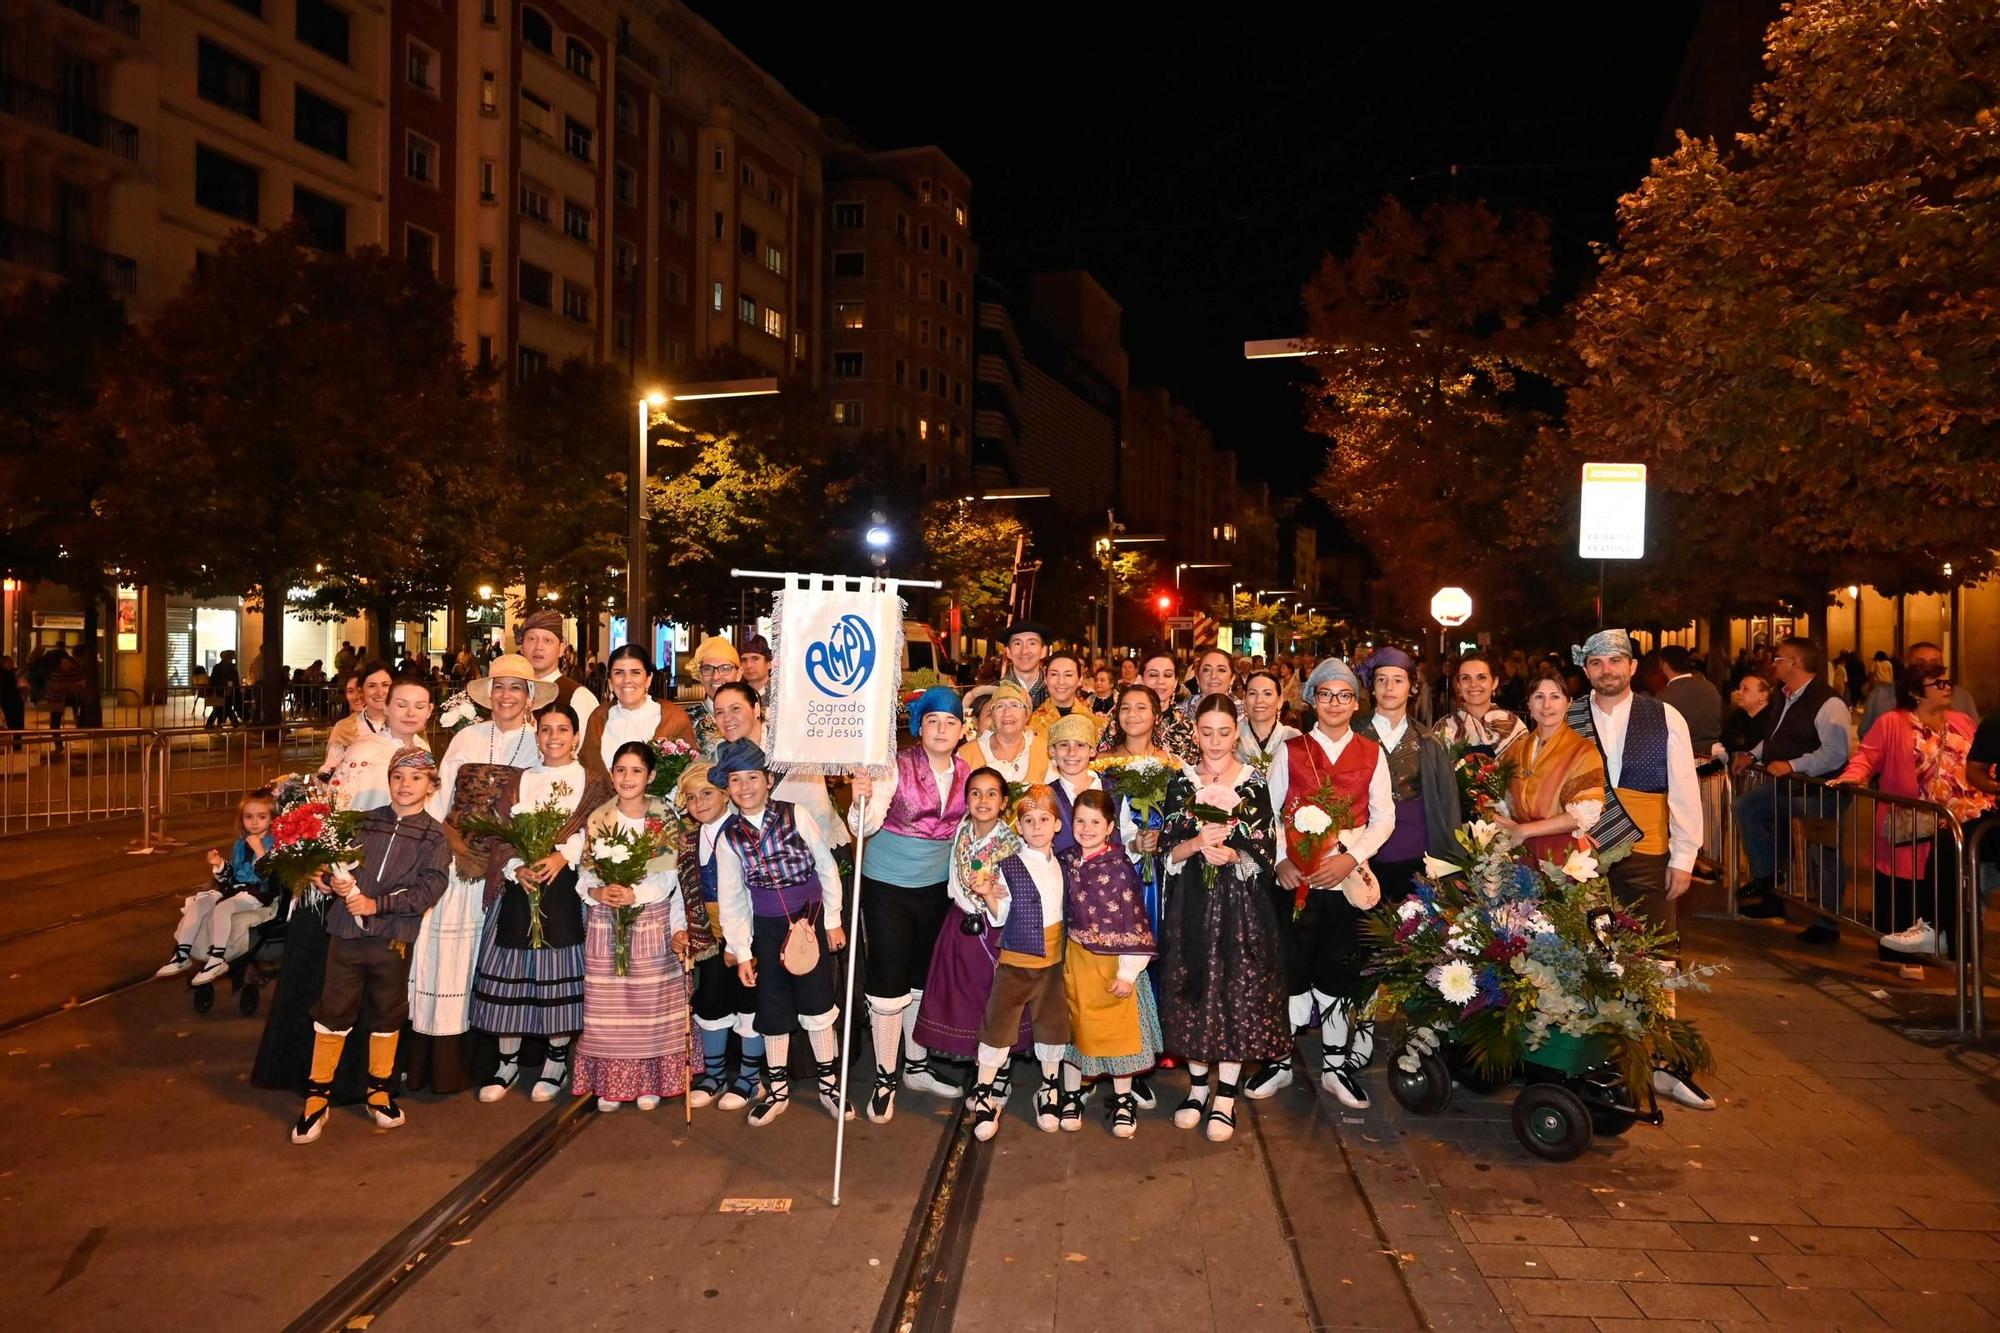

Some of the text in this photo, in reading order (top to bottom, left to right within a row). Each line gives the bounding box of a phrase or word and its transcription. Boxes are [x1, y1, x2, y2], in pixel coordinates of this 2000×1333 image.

[805, 614, 876, 698] AMPA
[808, 700, 866, 716] Sagrado
[806, 712, 864, 726] Corazón
[806, 726, 863, 738] de Jesús
